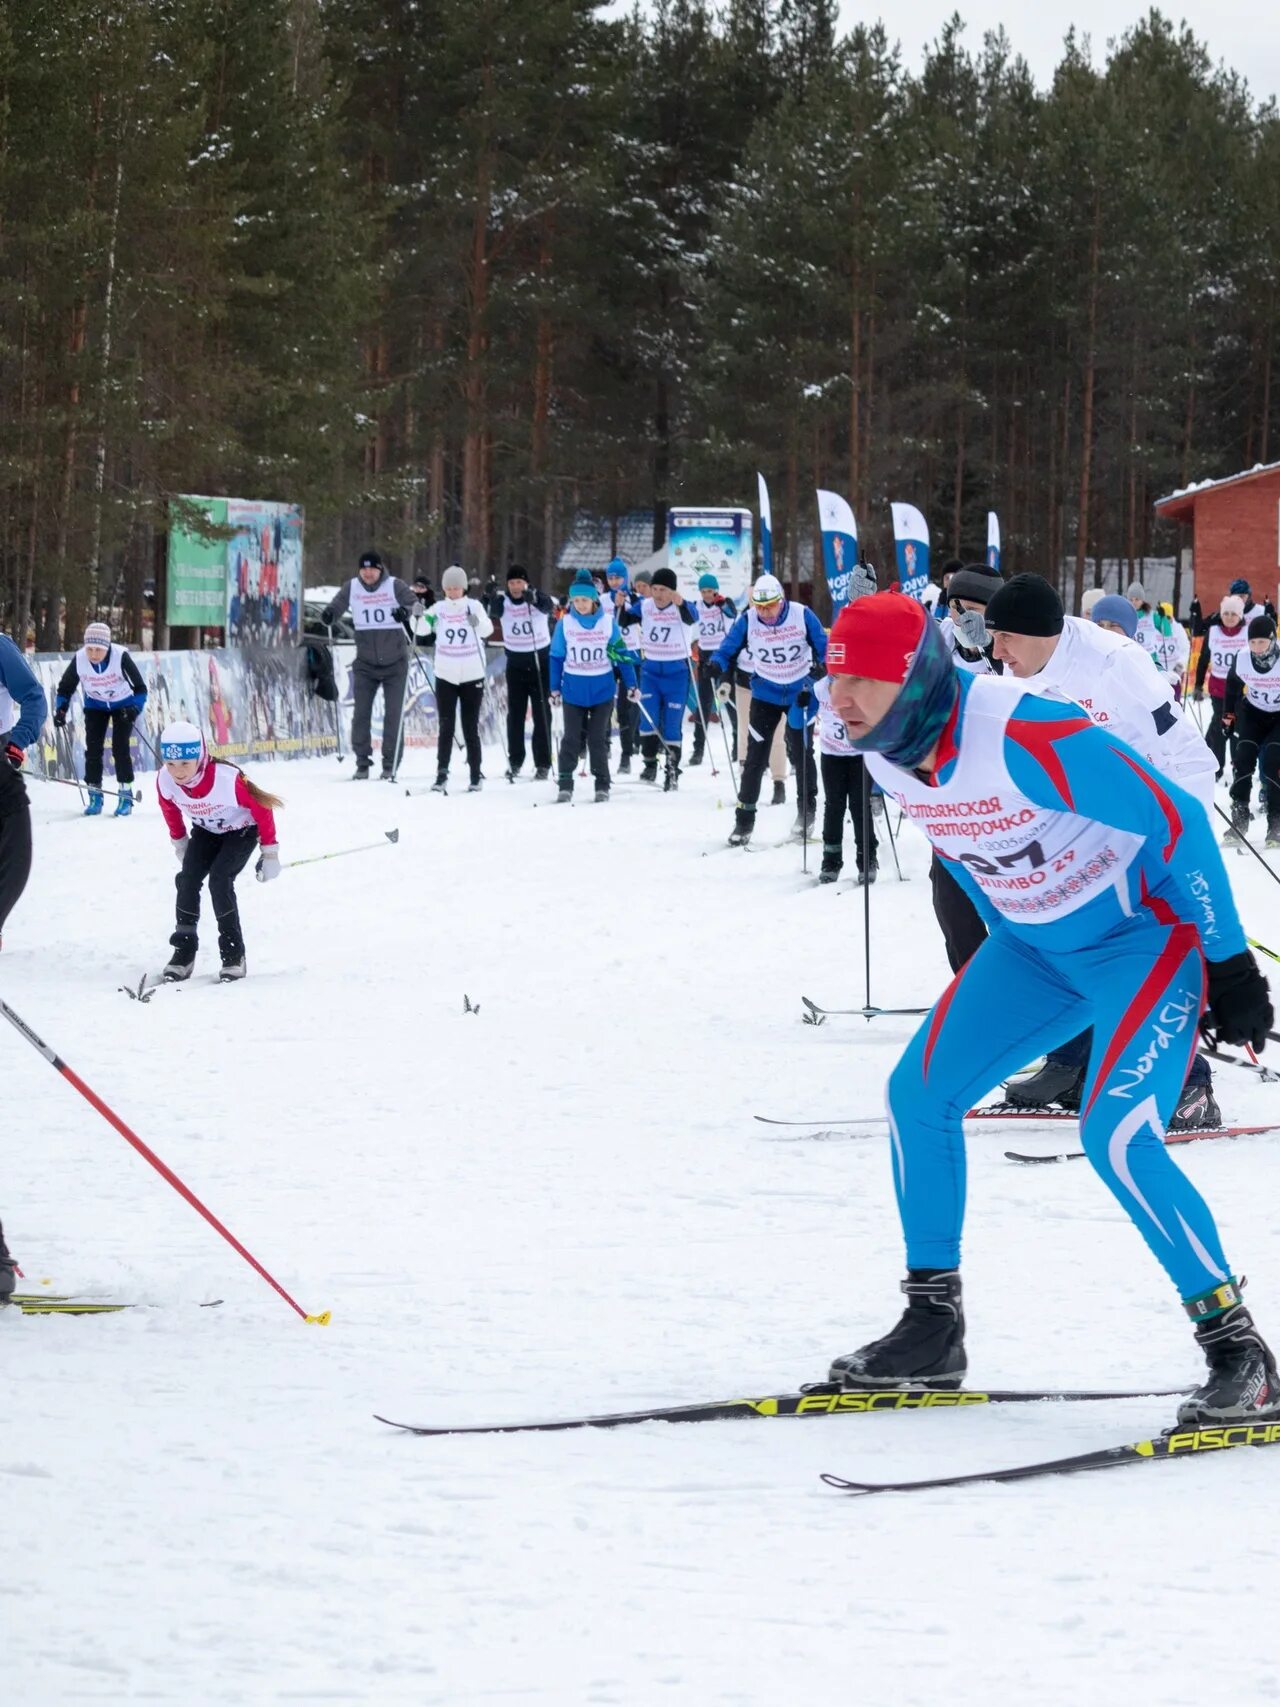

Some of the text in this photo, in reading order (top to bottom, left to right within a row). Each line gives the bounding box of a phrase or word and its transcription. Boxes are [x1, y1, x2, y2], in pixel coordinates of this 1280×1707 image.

[362, 608, 385, 623] 10
[445, 628, 468, 644] 99
[511, 620, 532, 636] 60
[649, 626, 672, 642] 67
[569, 646, 603, 662] 100
[758, 645, 802, 664] 252
[894, 791, 1003, 820] Устьянская
[926, 807, 1035, 841] пятерочка
[1050, 849, 1075, 873] 29
[1108, 988, 1201, 1099] NordSki
[977, 1107, 1081, 1116] MADSHU
[1166, 1126, 1230, 1137] ADSHUS
[796, 1392, 989, 1414] FISCHER
